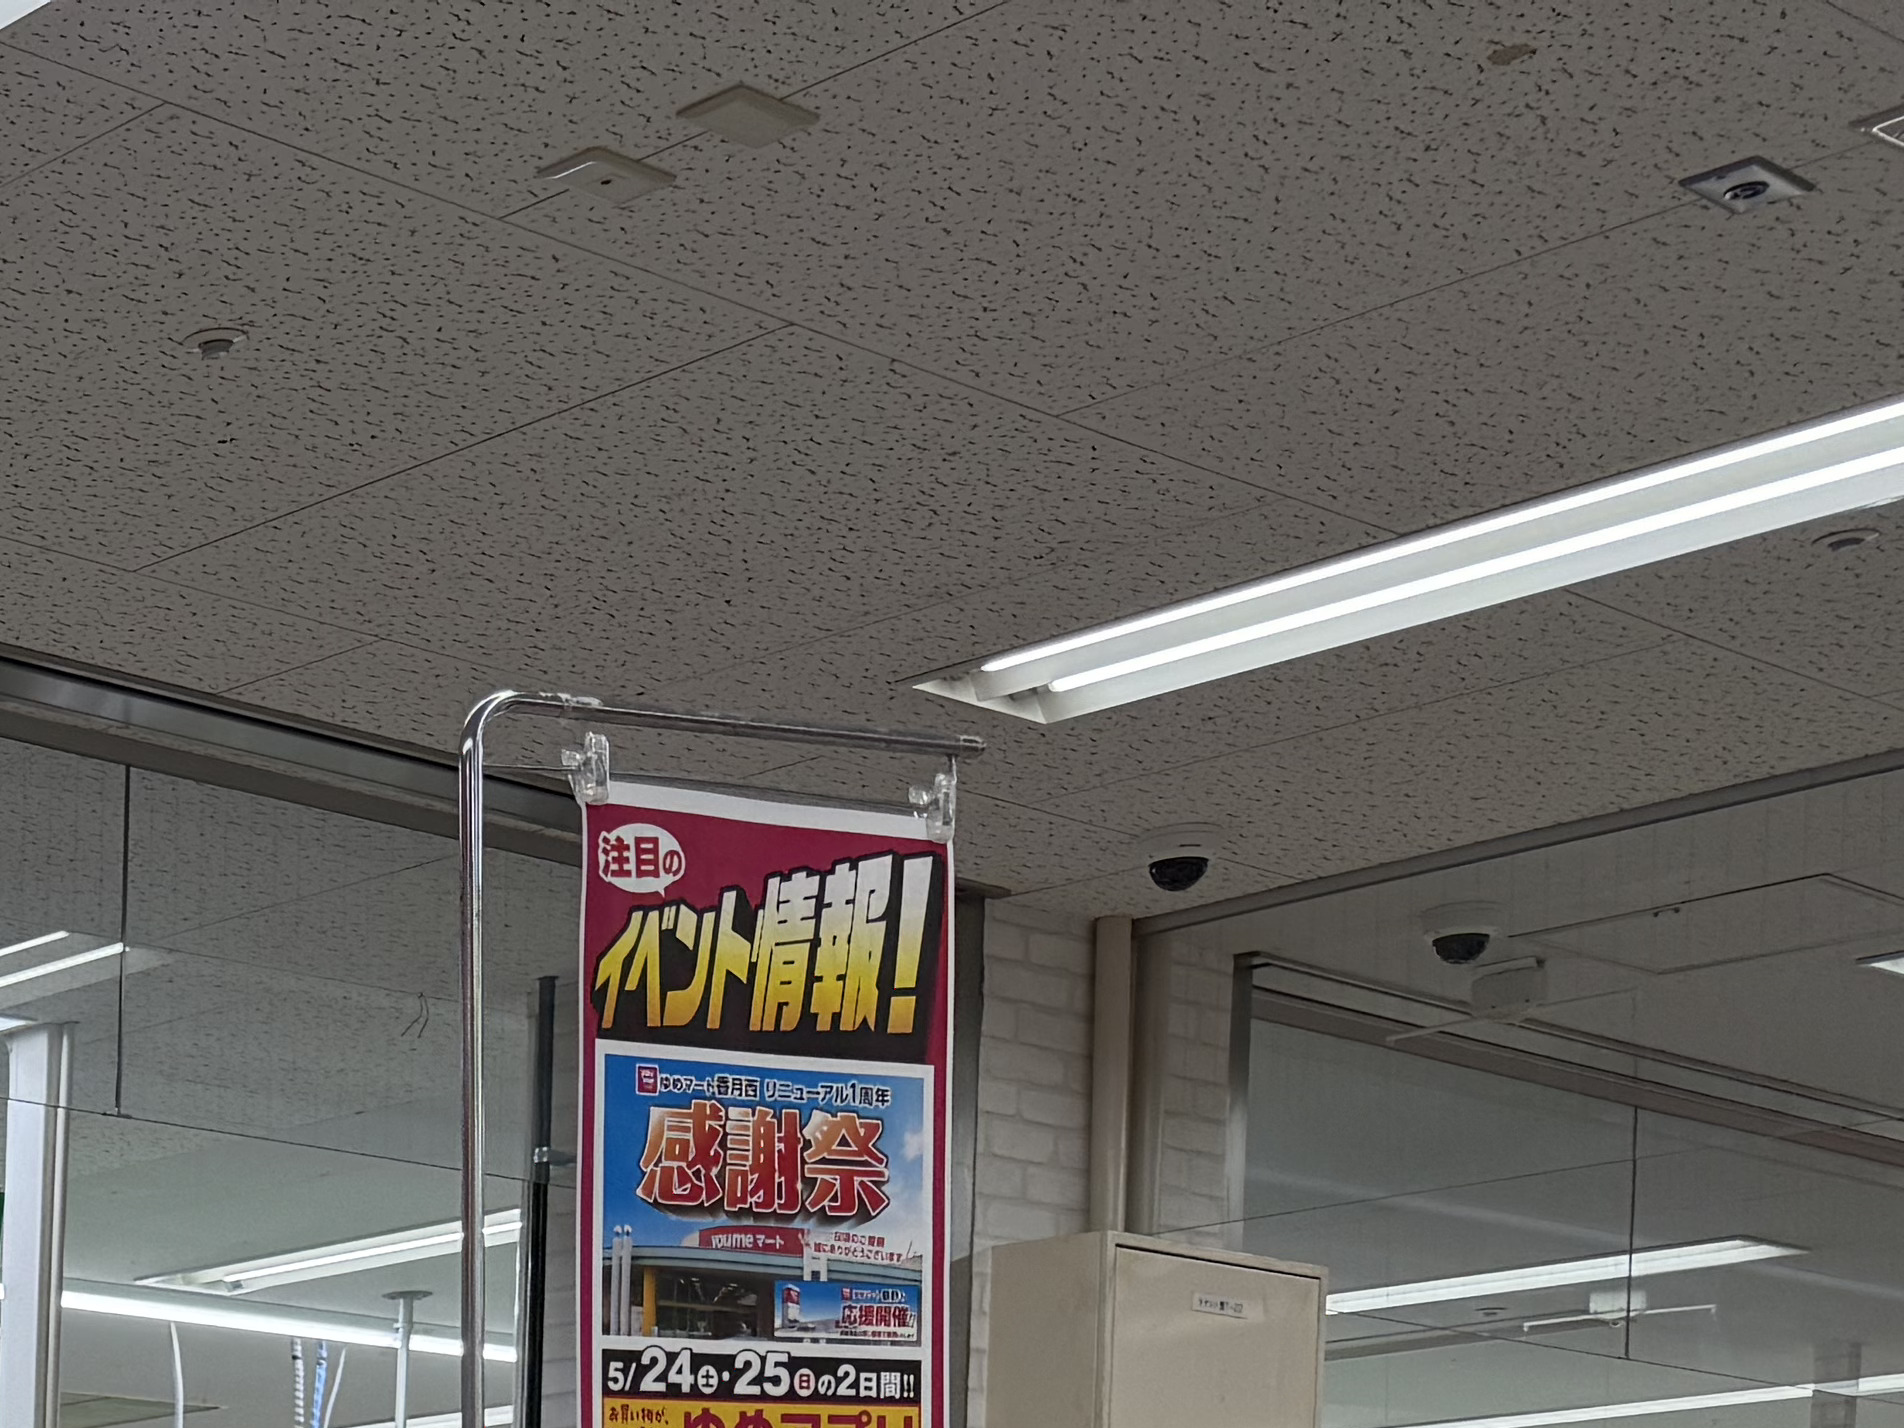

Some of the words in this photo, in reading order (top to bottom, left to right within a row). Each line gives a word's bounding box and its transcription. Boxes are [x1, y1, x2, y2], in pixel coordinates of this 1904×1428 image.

[600, 835, 683, 880] 注目の
[592, 850, 934, 1036] イベント情報!
[763, 1078, 891, 1107] リニューアル1周年
[637, 1100, 890, 1217] 感謝祭
